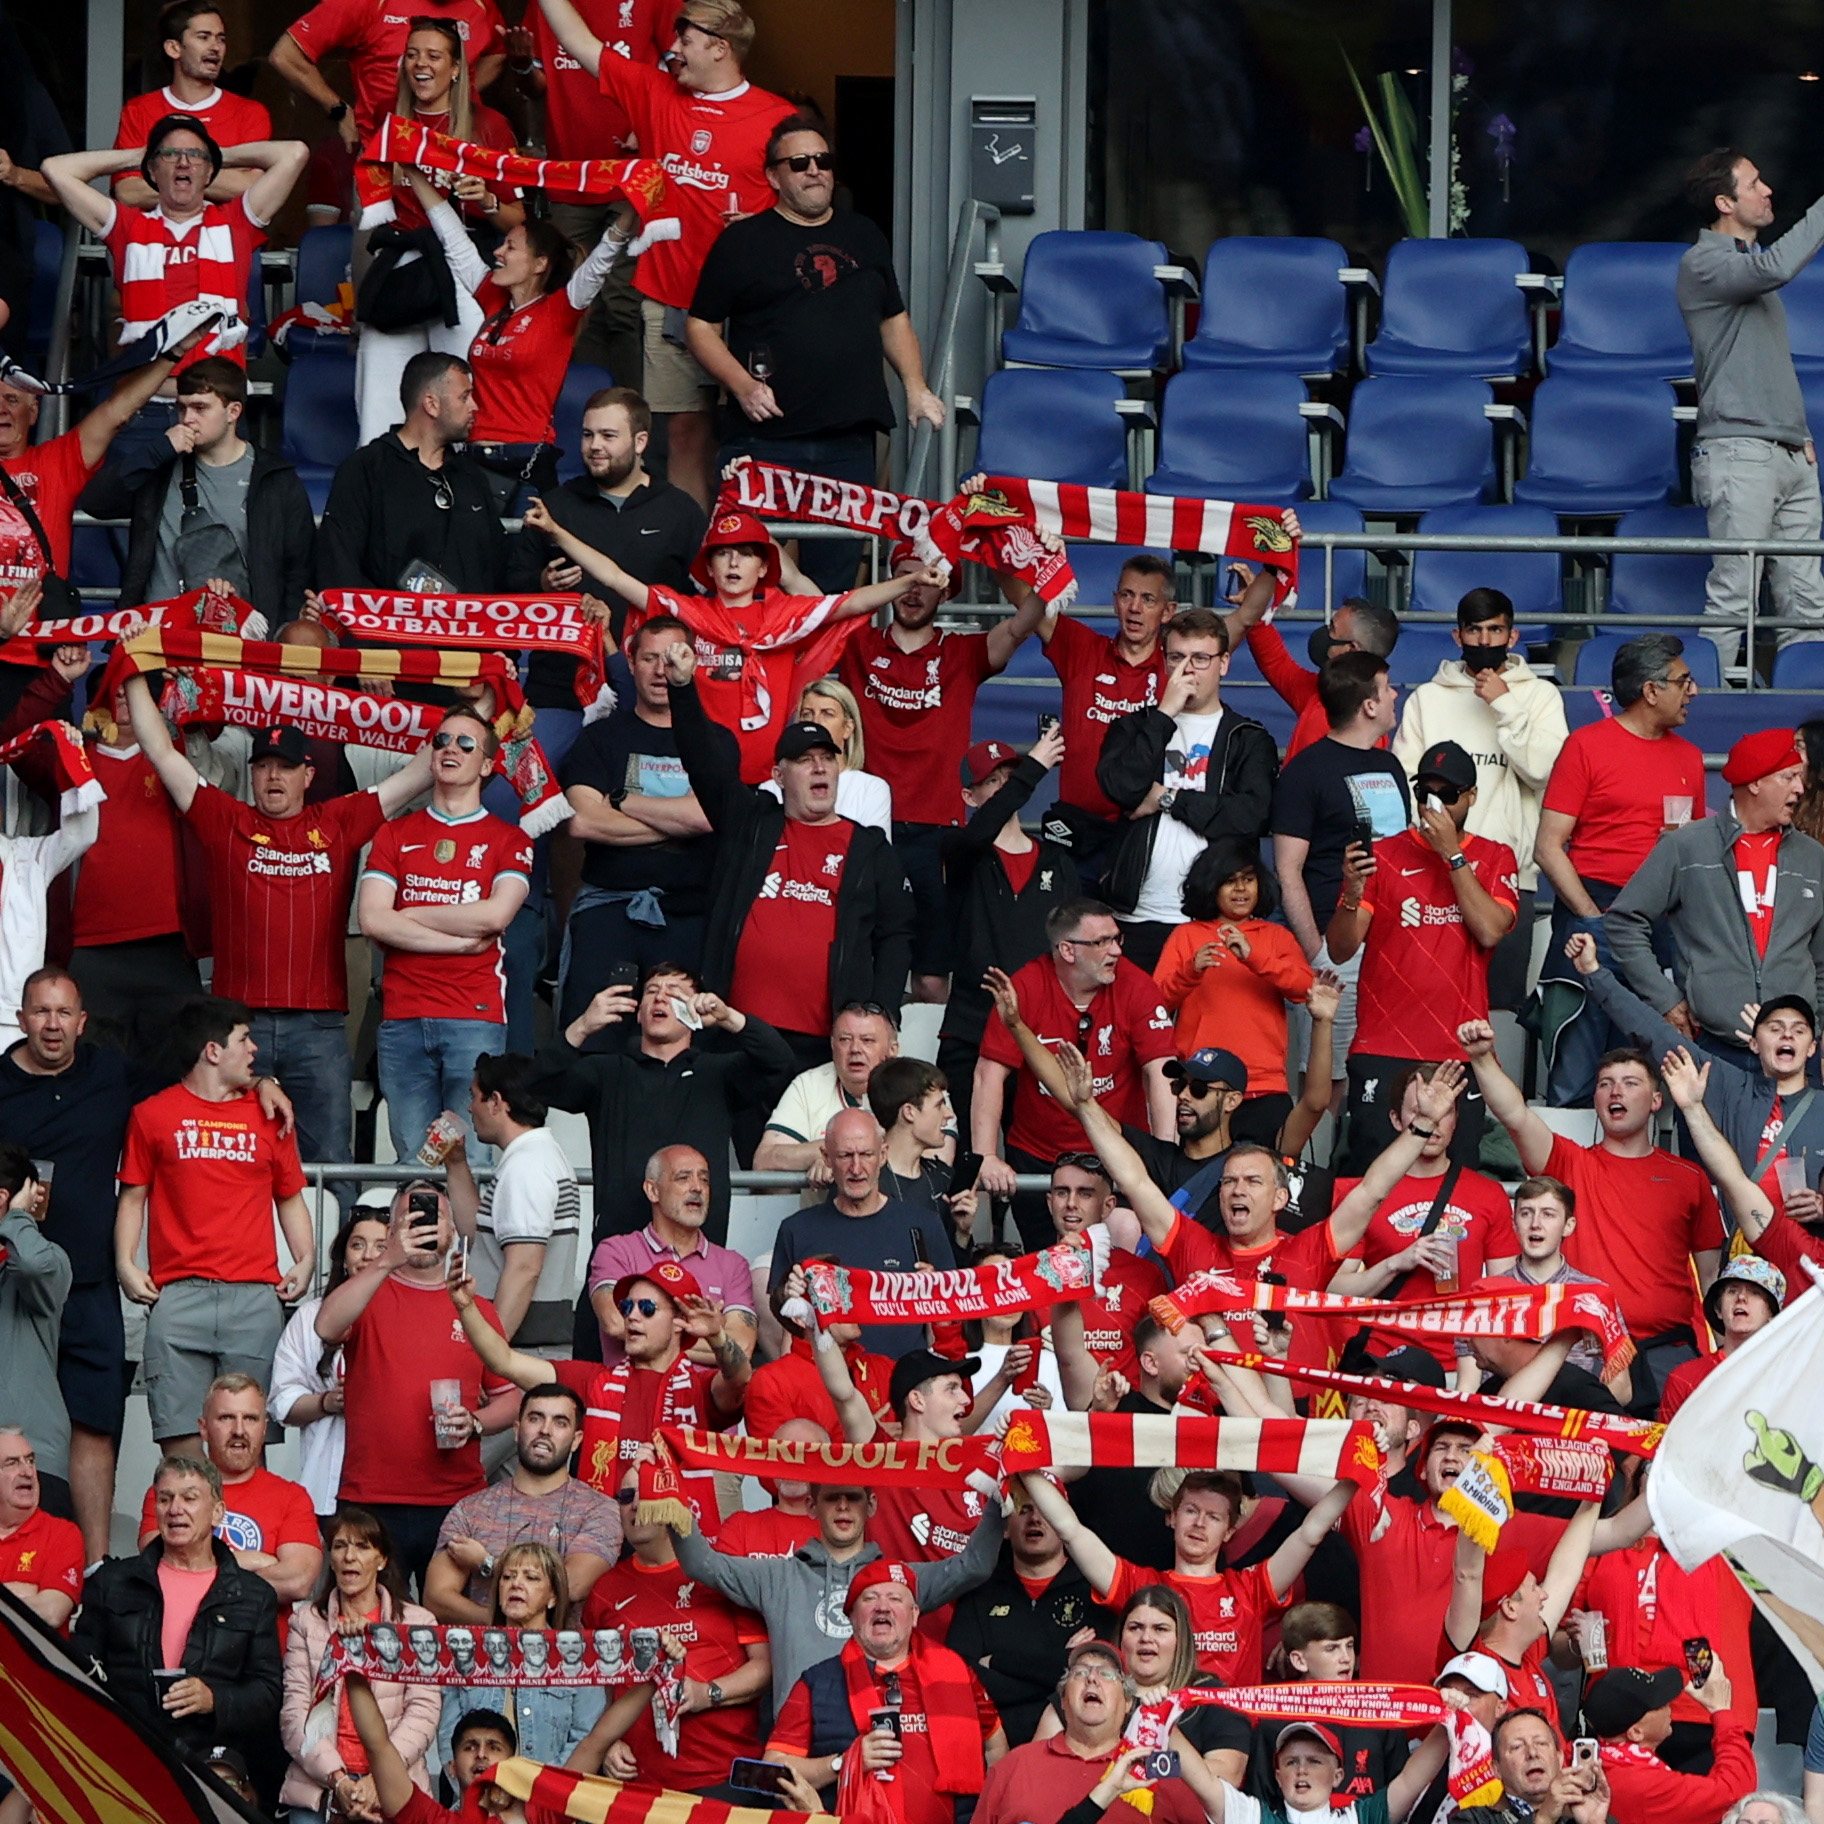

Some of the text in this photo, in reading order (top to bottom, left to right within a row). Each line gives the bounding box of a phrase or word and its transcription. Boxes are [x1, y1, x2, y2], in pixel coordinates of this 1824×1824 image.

[661, 153, 729, 190] Carlsberg
[496, 623, 580, 641] CLUB
[868, 674, 925, 701] Standard
[222, 672, 434, 738] LIVERPOOL
[358, 729, 410, 751] WALK
[255, 847, 315, 864] Standard
[248, 860, 313, 876] Chartered
[406, 874, 461, 891] Standard
[403, 889, 458, 905] Chartered
[179, 1147, 255, 1163] LIVERPOOL
[869, 1257, 1021, 1301] LIVERPOOL FC
[871, 1286, 1030, 1316] YOU'LL NEVER WALK ALONE
[684, 1429, 964, 1472] LIVERPOOL FC
[1532, 1438, 1593, 1452] THE LEAGUE
[1552, 1479, 1592, 1492] ENGLAND
[1407, 1702, 1441, 1714] SAID SO
